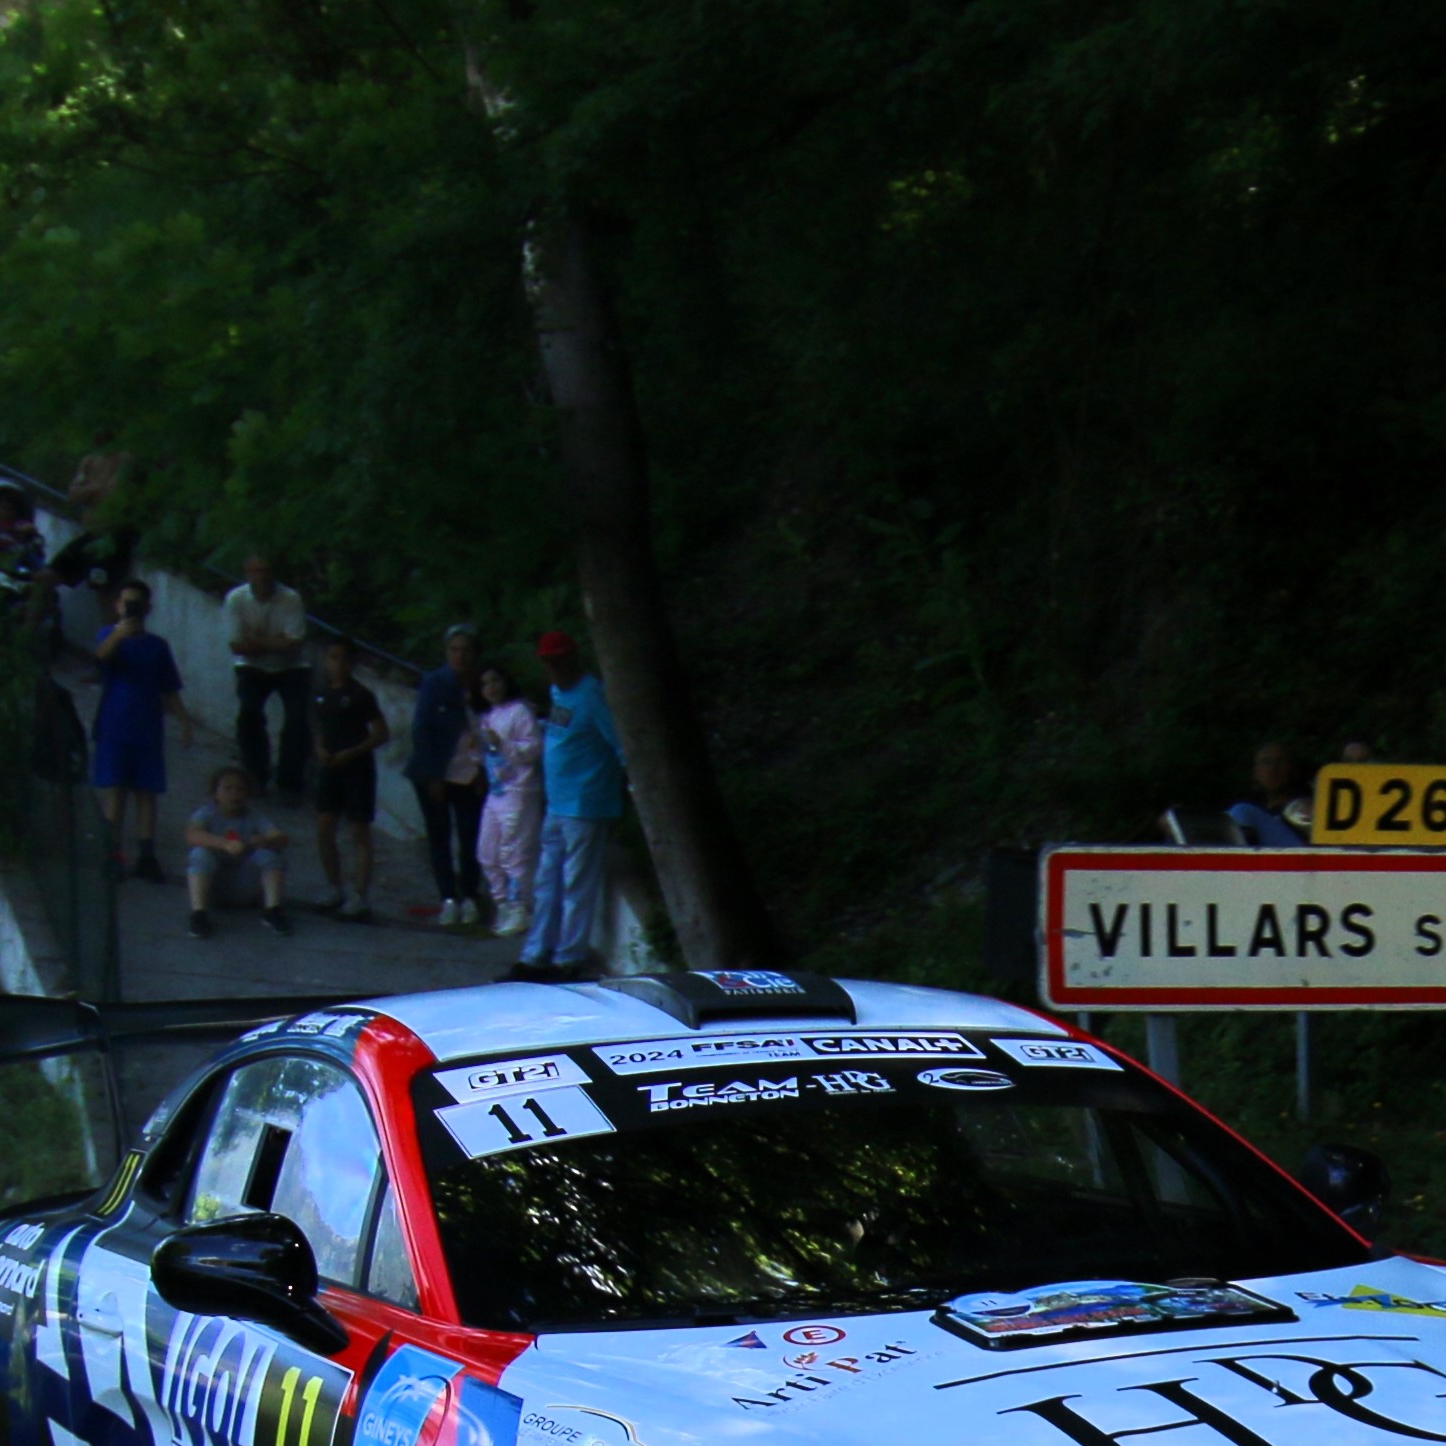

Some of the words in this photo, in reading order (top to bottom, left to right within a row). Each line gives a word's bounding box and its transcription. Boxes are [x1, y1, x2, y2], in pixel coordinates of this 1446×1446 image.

[1089, 902, 1377, 958] VILLARS
[609, 1049, 685, 1065] 2024
[813, 1033, 964, 1053] CANAL+
[636, 1075, 799, 1102] TEAM
[649, 1088, 800, 1112] BONNETON
[488, 1098, 568, 1144] 11
[97, 1153, 141, 1216] 11
[4, 1221, 46, 1250] auto
[731, 1372, 833, 1410] Arti
[825, 1343, 918, 1374] Pat
[522, 1412, 582, 1444] GROUPE
